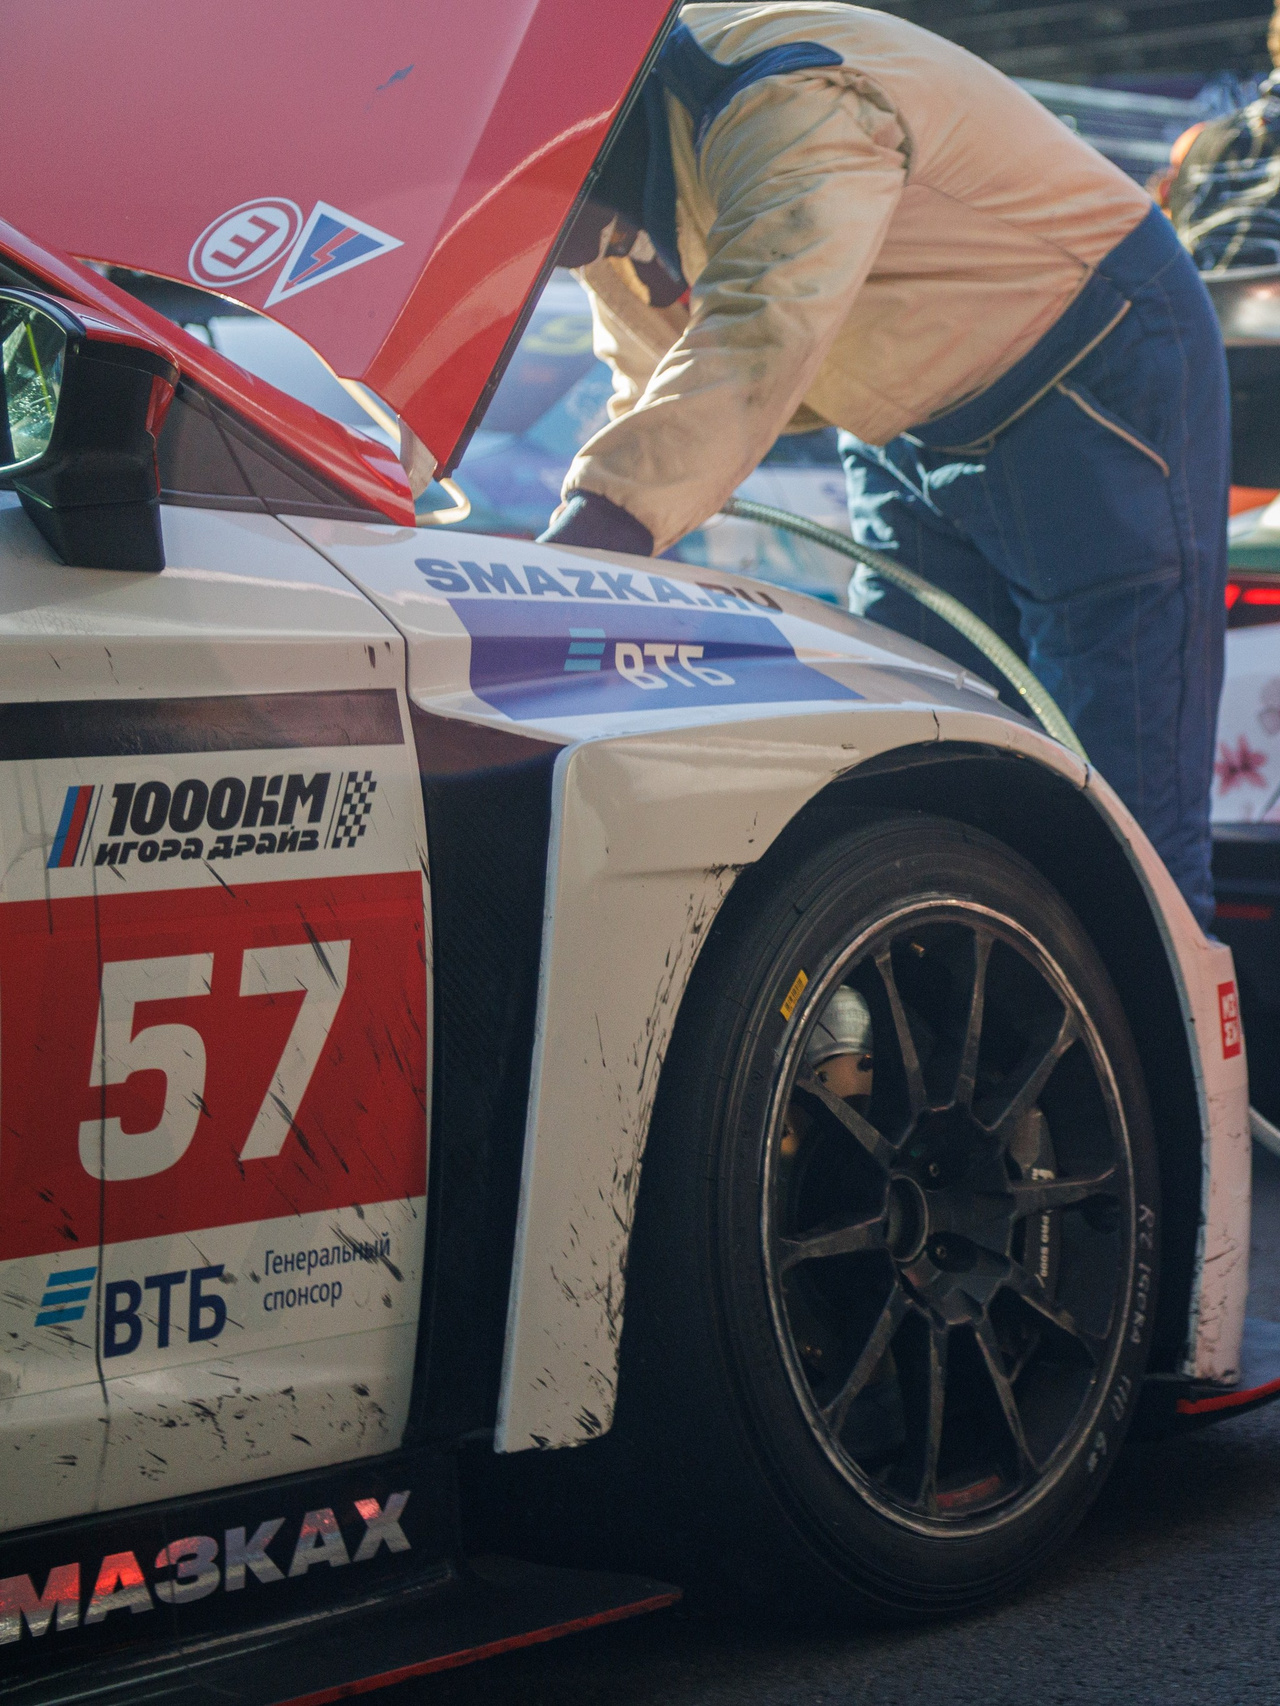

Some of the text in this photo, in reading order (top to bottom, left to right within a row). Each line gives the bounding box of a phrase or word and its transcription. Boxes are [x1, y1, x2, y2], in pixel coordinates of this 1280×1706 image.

[413, 557, 784, 615] SMAZKA.RU
[614, 641, 736, 691] ВТБ
[78, 939, 352, 1182] 57
[264, 1231, 391, 1276] Генеральный
[103, 1263, 228, 1359] ВТБ
[262, 1280, 343, 1312] спонсор
